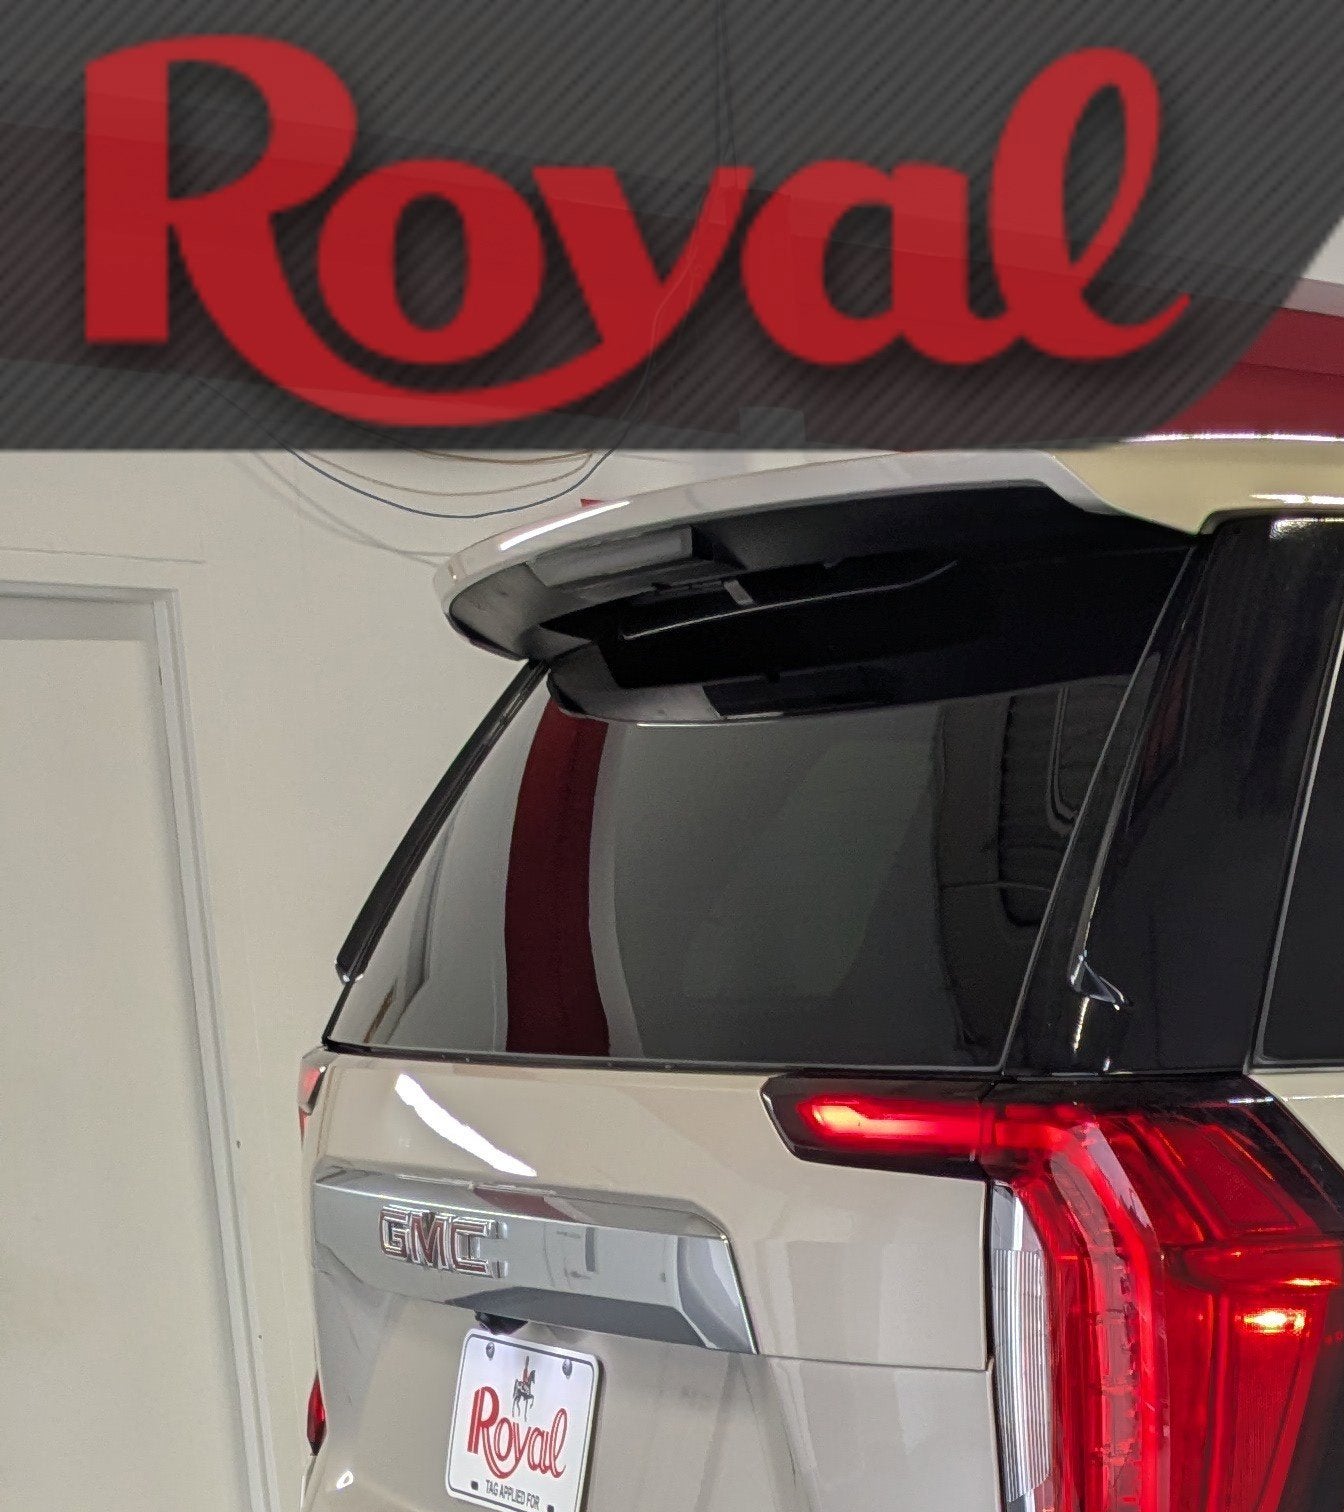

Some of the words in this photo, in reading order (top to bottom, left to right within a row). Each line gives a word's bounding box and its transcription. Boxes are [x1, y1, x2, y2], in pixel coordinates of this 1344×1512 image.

[379, 1204, 504, 1279] GMC
[467, 1386, 569, 1480] Royal
[485, 1479, 499, 1497] TAG
[499, 1484, 526, 1505] APPLIED
[526, 1492, 540, 1511] FOR
